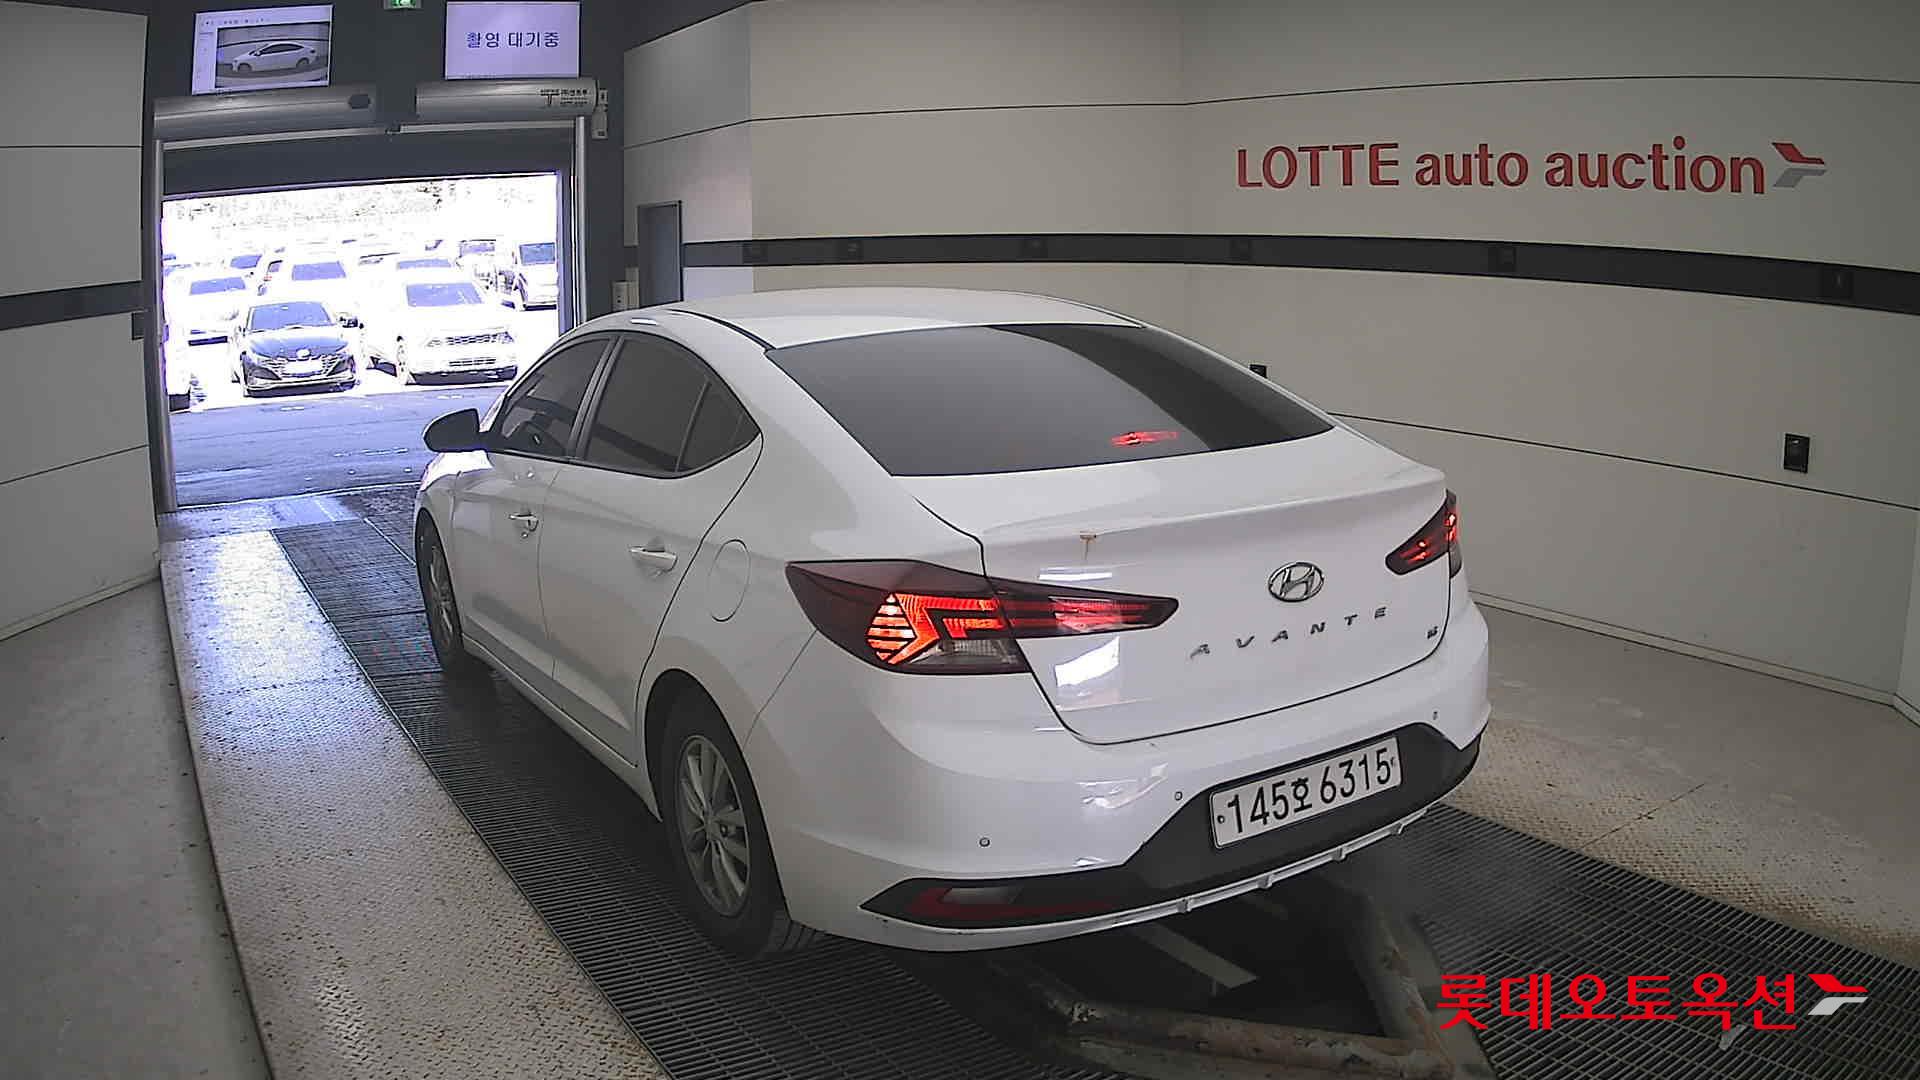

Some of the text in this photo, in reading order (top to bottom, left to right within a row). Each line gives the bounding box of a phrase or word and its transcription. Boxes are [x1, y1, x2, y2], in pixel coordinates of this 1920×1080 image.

[508, 32, 560, 48] 대기중
[1237, 135, 1766, 195] LOTTE auto auction
[1190, 606, 1388, 660] AVANTE
[1227, 747, 1392, 834] 145호 6315
